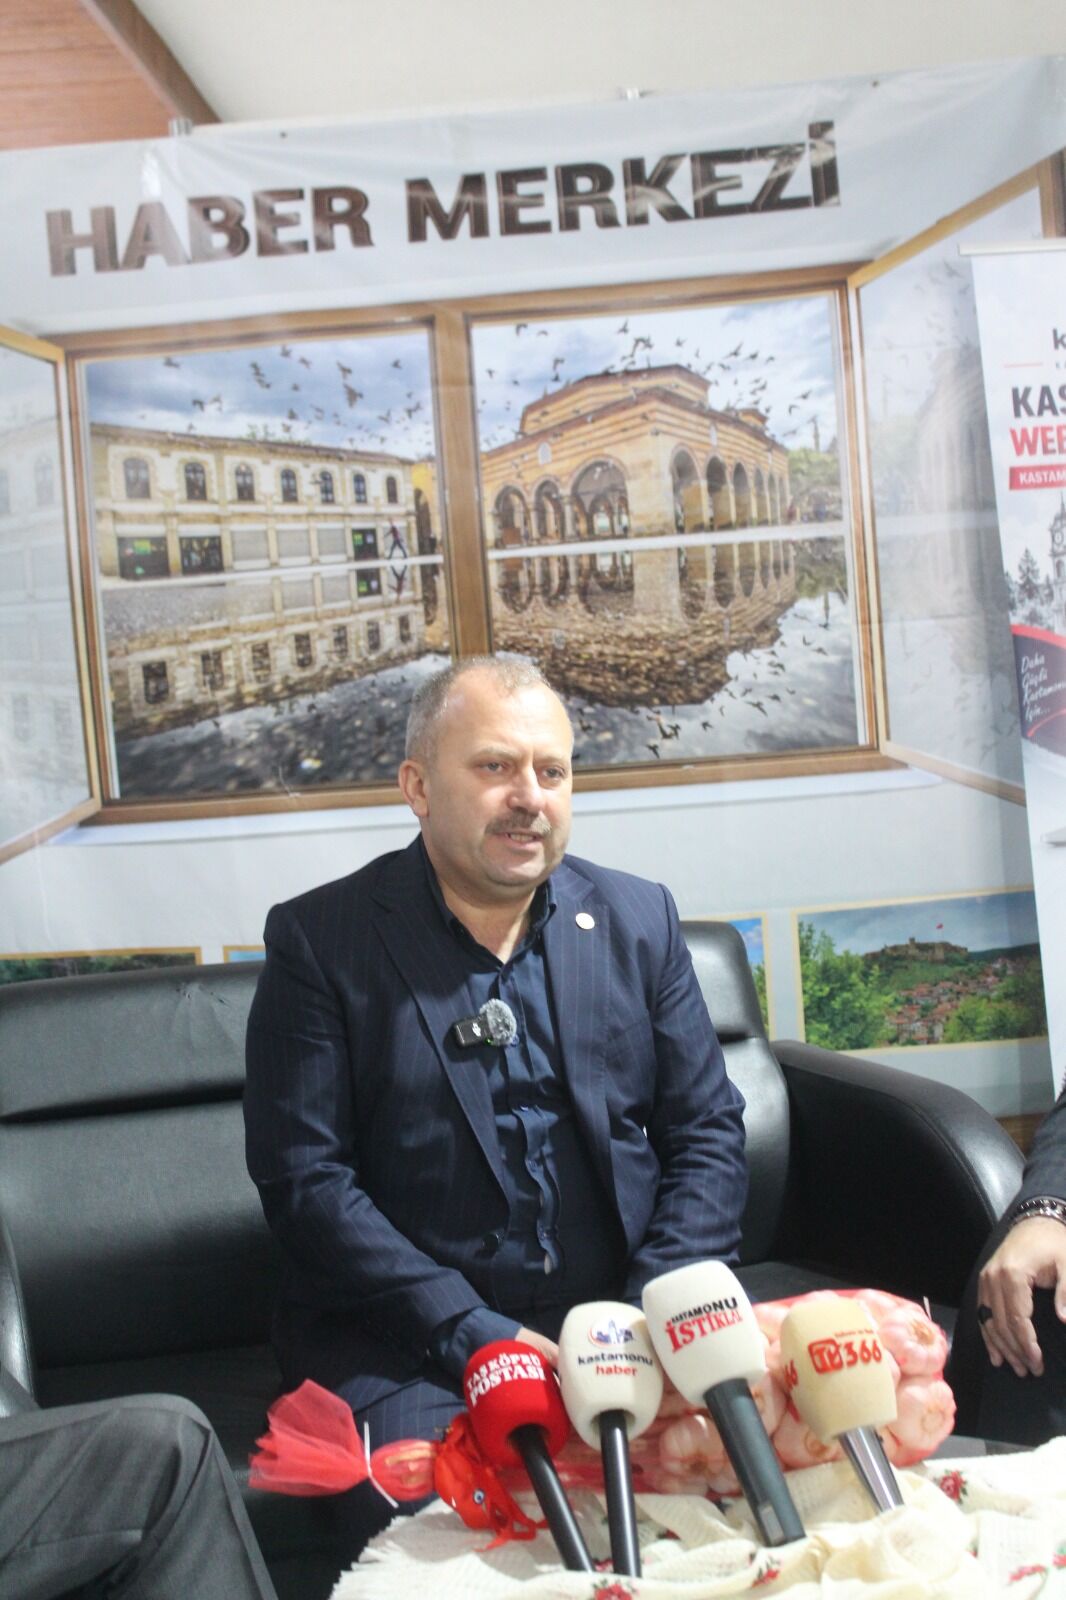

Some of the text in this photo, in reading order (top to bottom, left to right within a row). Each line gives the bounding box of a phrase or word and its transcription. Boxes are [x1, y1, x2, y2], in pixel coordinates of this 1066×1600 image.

[45, 120, 841, 277] HABER MERKEZİ
[671, 1296, 738, 1324] KASTAMONU
[577, 1352, 654, 1367] kastamonu
[596, 1364, 638, 1377] haber
[470, 1364, 546, 1407] POSTASI
